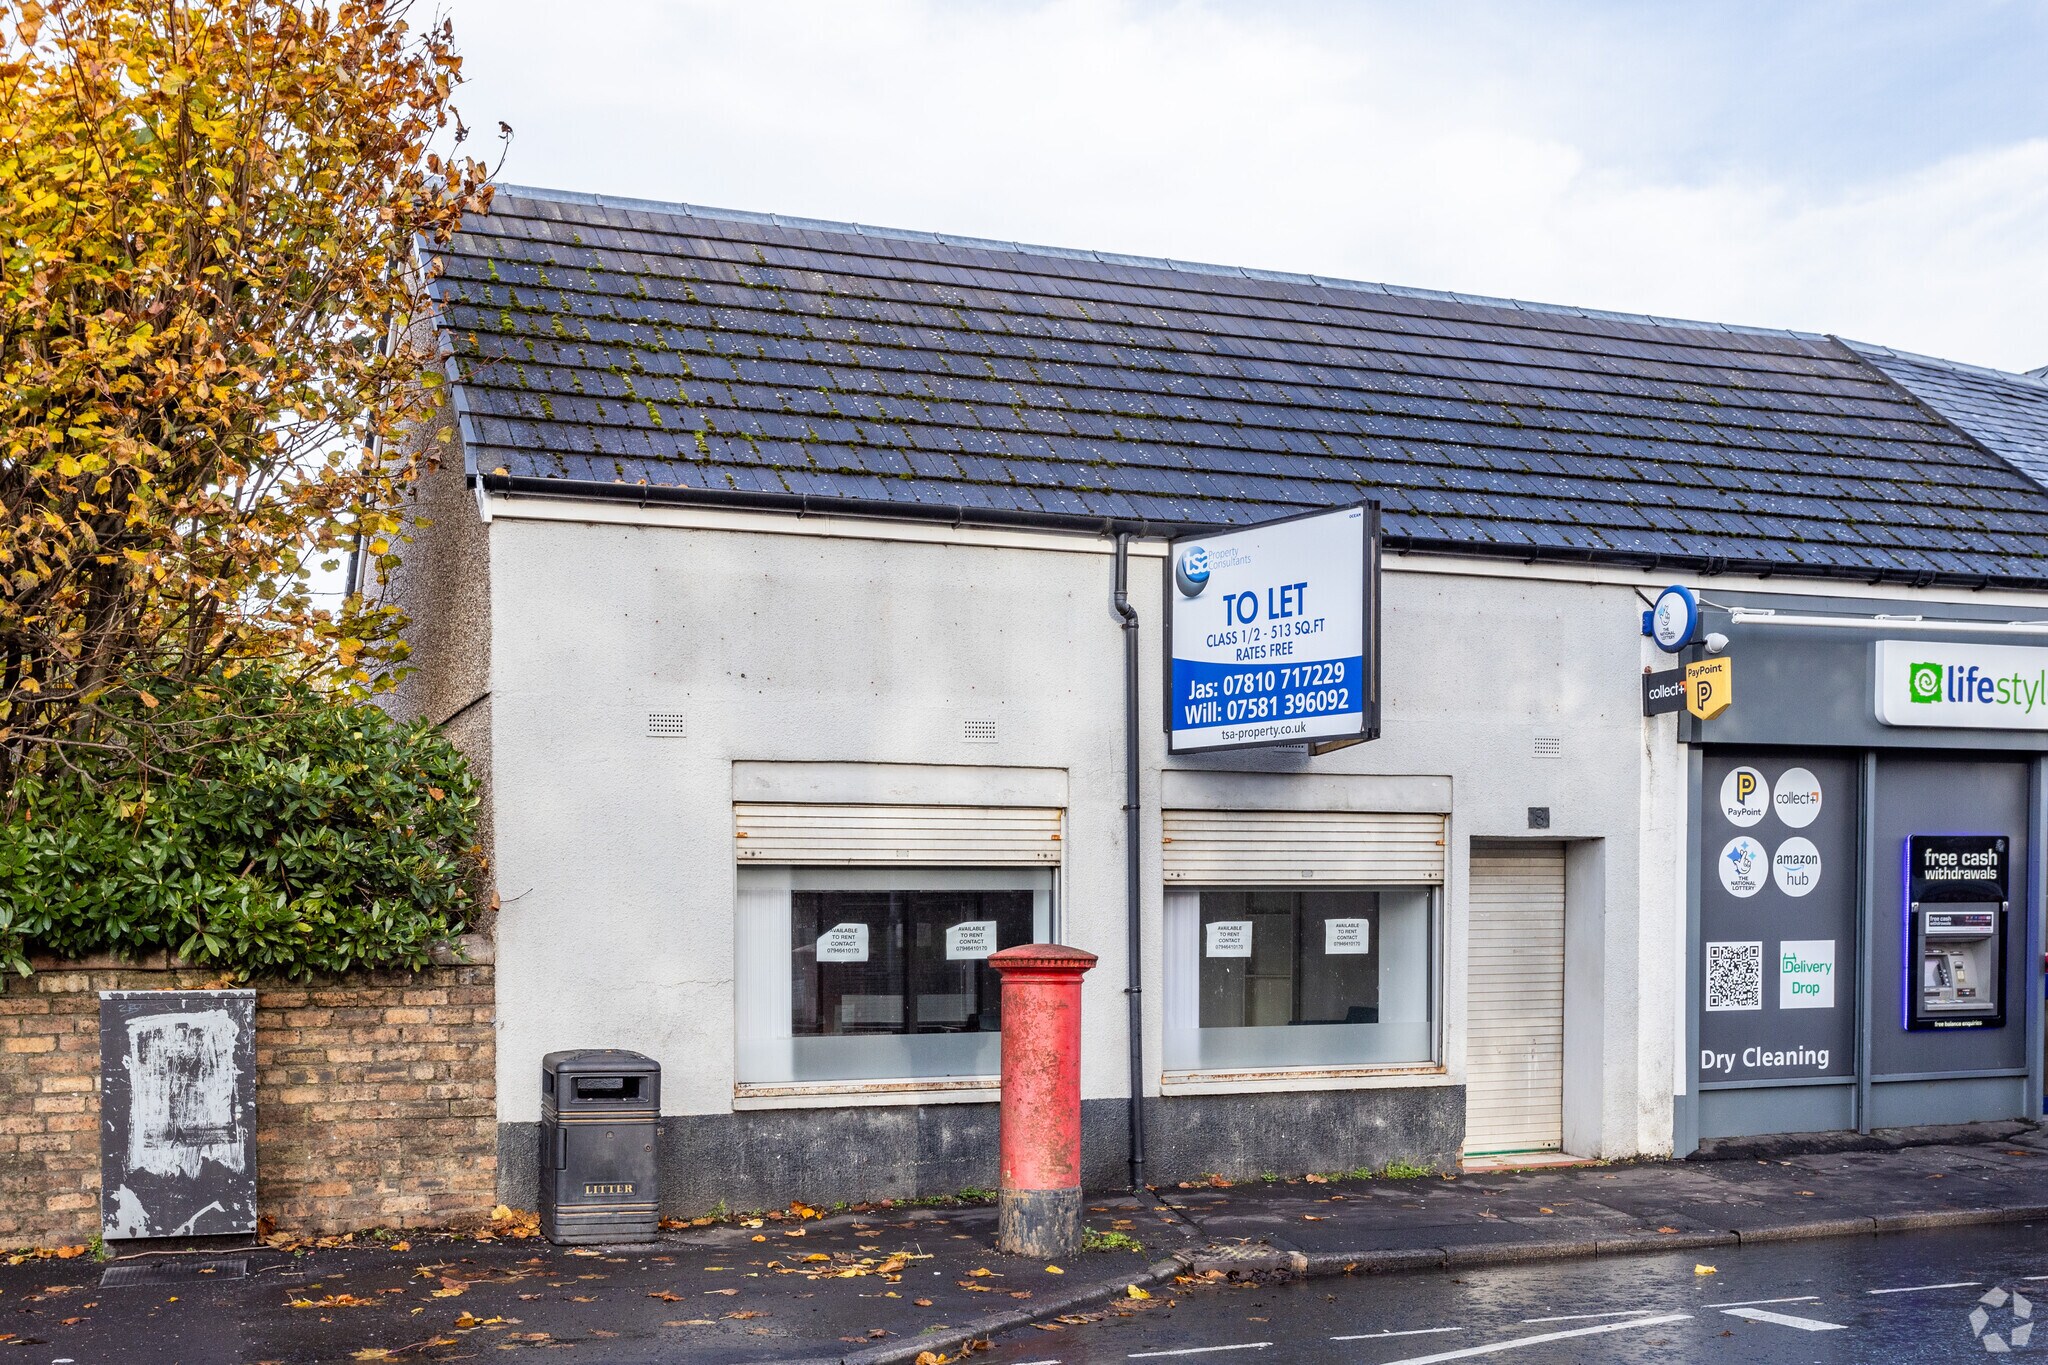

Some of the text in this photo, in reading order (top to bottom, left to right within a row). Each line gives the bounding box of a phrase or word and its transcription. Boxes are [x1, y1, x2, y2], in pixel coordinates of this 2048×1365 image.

[1208, 546, 1239, 561] Property
[1208, 554, 1252, 571] Consultants
[1184, 553, 1210, 575] tsa
[1223, 582, 1308, 627] TO LET
[1206, 632, 1238, 648] CLASS
[1242, 628, 1260, 644] 1/2
[1271, 623, 1291, 640] 513
[1295, 618, 1325, 635] SQ.FT
[1236, 641, 1293, 661] RATES FREE
[1687, 664, 1723, 678] PayPoint
[1188, 661, 1345, 700] Jas: 07810 717229
[1948, 665, 2048, 714] lifestyl
[1649, 682, 1685, 700] collect+
[1696, 680, 1713, 711] P
[1185, 688, 1349, 725] Will: 07581 396092
[1221, 721, 1307, 740] tsa-property.co.uk
[1737, 771, 1757, 806] P
[1776, 792, 1817, 804] collect+
[1535, 808, 1544, 826] 8
[1728, 808, 1762, 817] PayPoint
[1776, 854, 1818, 865] amazon
[1925, 848, 1998, 866] free cash
[1786, 872, 1809, 886] hub
[1925, 867, 1997, 880] withdrawals
[1783, 957, 1832, 975] Delivery
[1792, 981, 1820, 996] Drop
[1701, 1045, 1830, 1074] Dry Cleaning
[585, 1184, 633, 1194] LITTER
